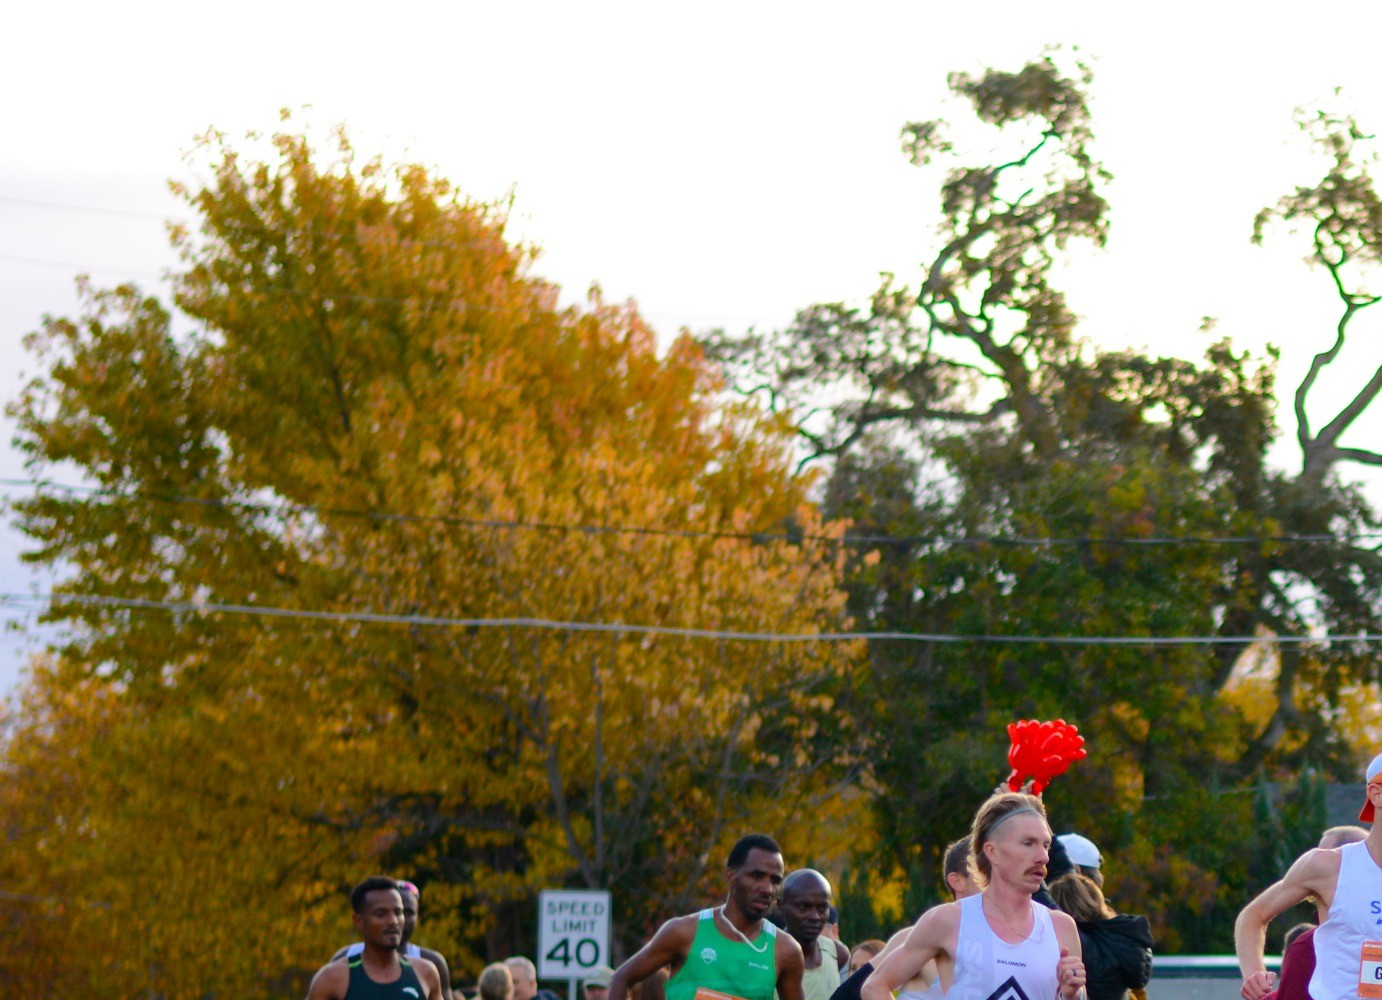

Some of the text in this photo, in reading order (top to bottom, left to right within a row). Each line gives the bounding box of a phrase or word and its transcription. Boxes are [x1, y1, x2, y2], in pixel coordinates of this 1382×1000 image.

[547, 901, 604, 915] SPEED
[552, 920, 597, 933] LIMIT
[545, 938, 600, 968] 40
[996, 959, 1027, 968] SALOMON
